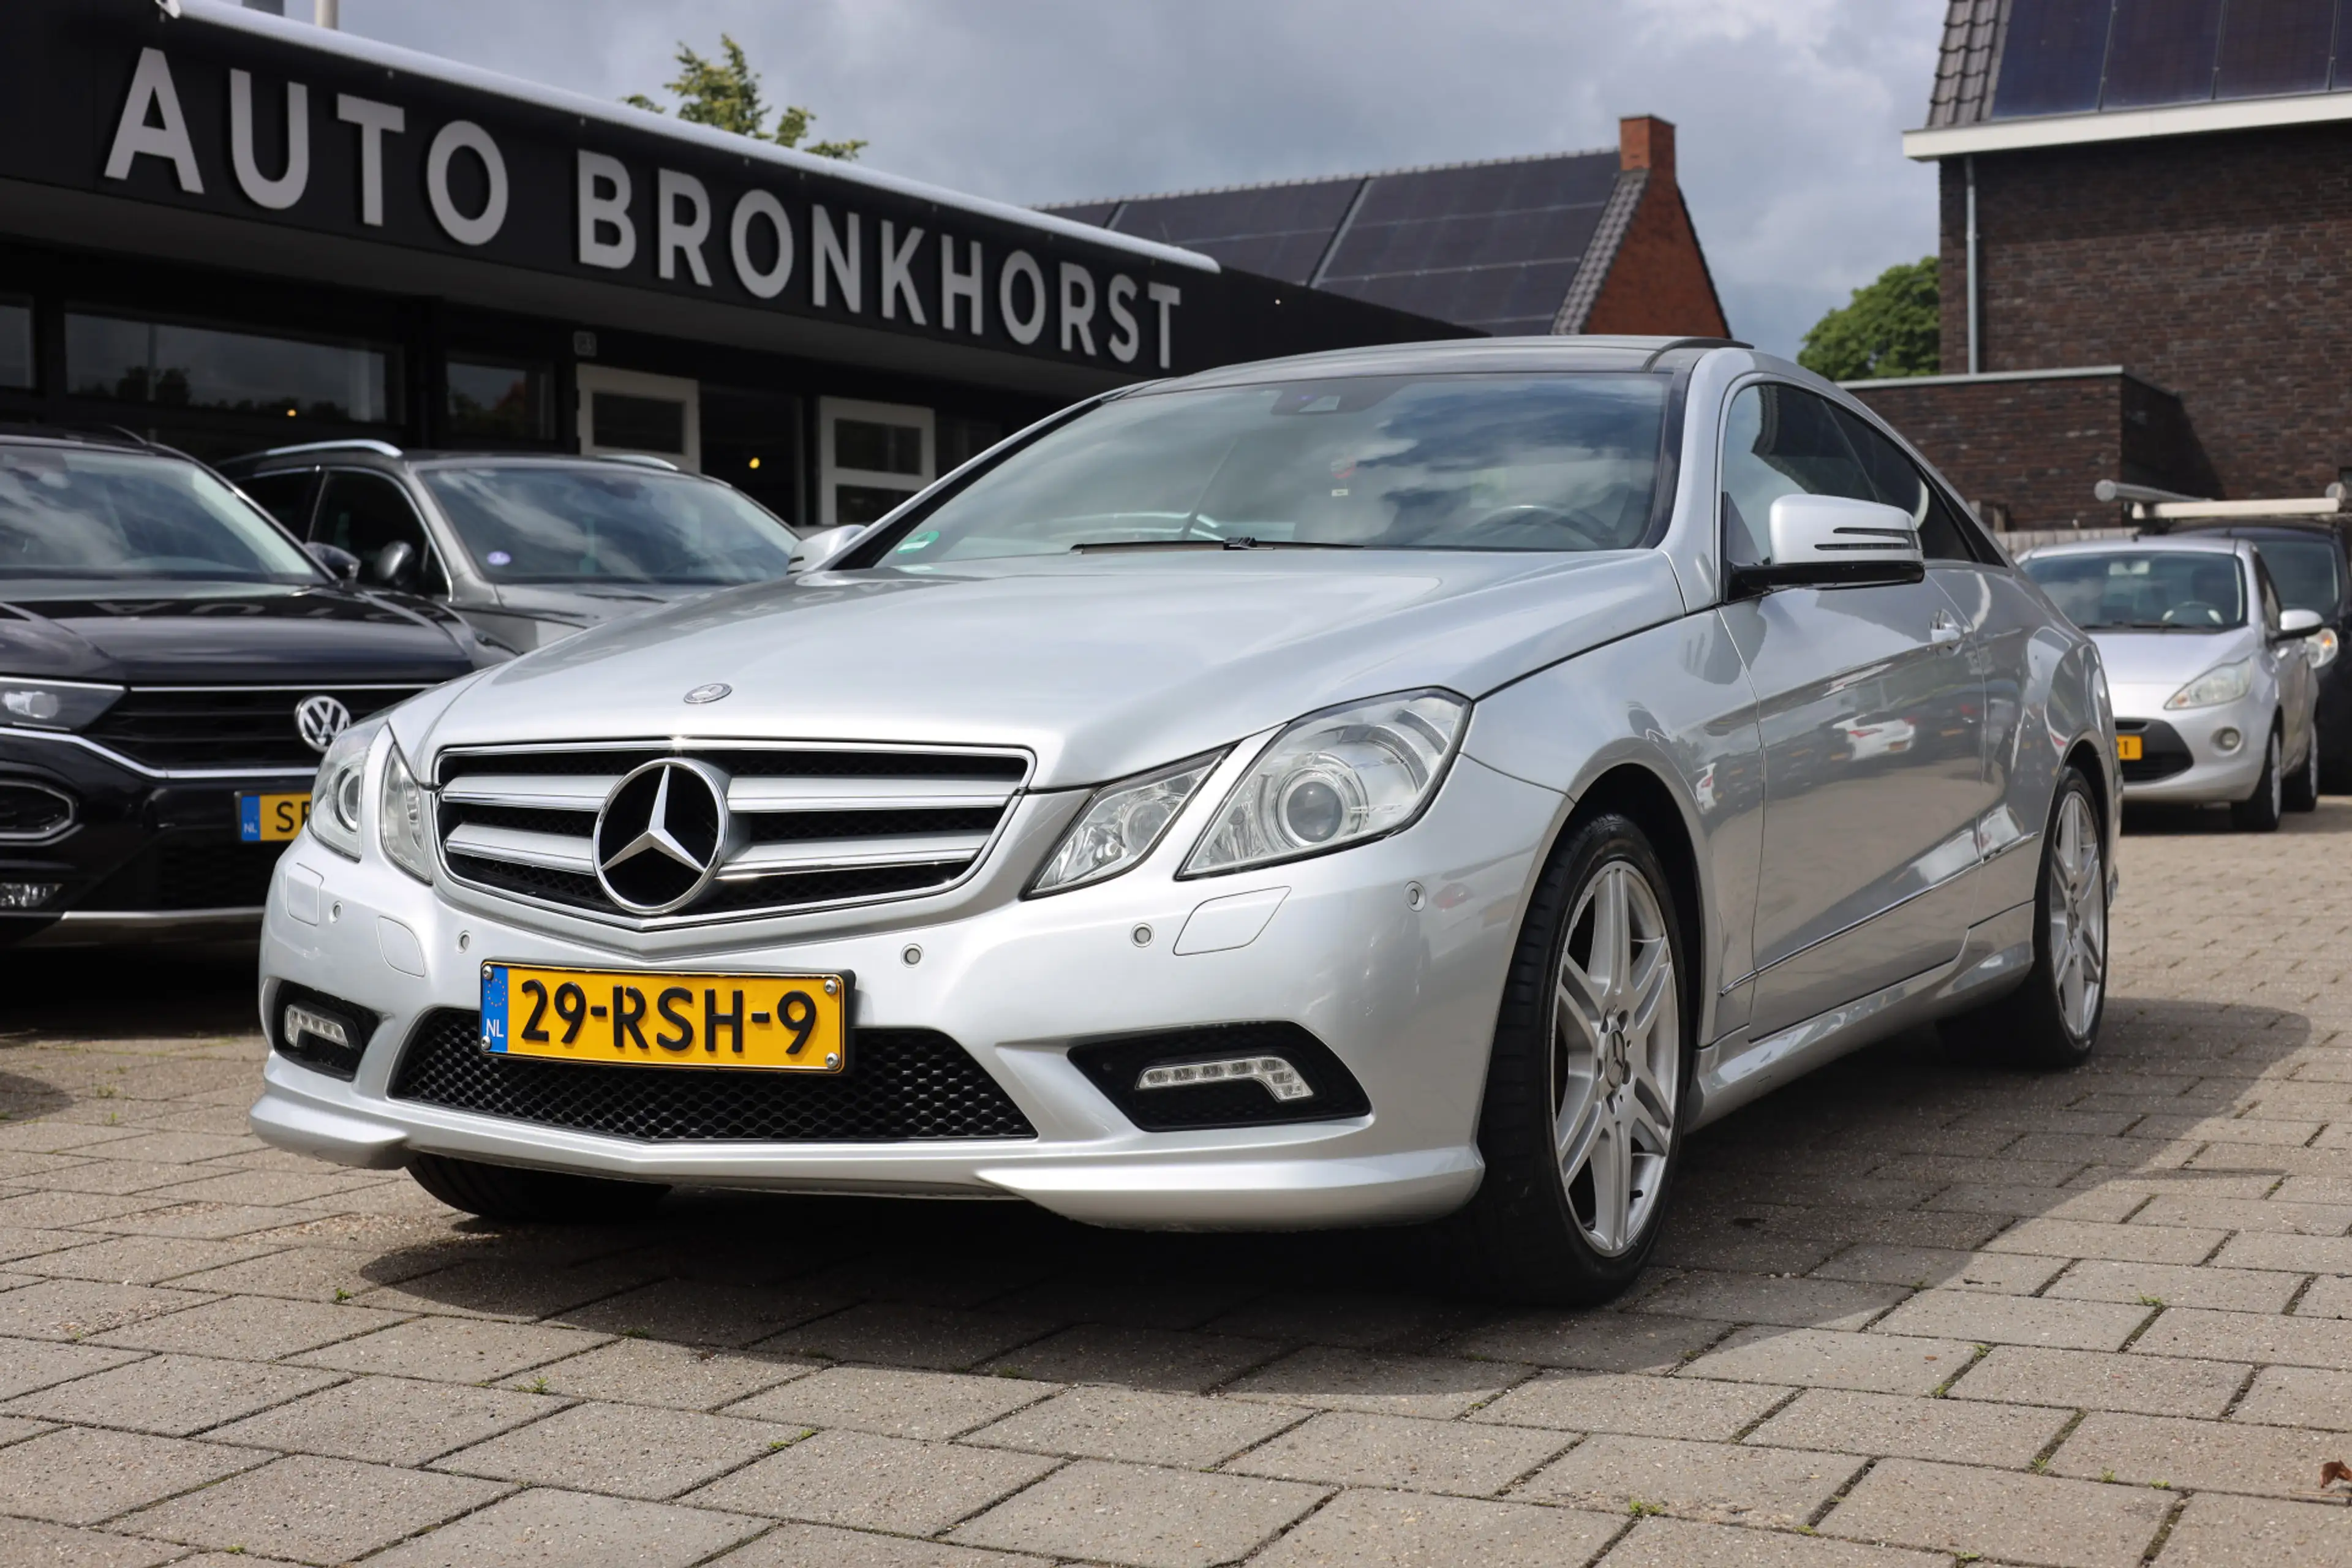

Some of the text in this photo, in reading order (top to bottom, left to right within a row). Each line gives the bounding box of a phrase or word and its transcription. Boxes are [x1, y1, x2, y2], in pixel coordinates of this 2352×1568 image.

[104, 47, 1180, 368] AUTO BRONKHORST
[244, 823, 257, 833] NL
[486, 1019, 504, 1038] NL
[521, 979, 817, 1054] 29-RSH-9
